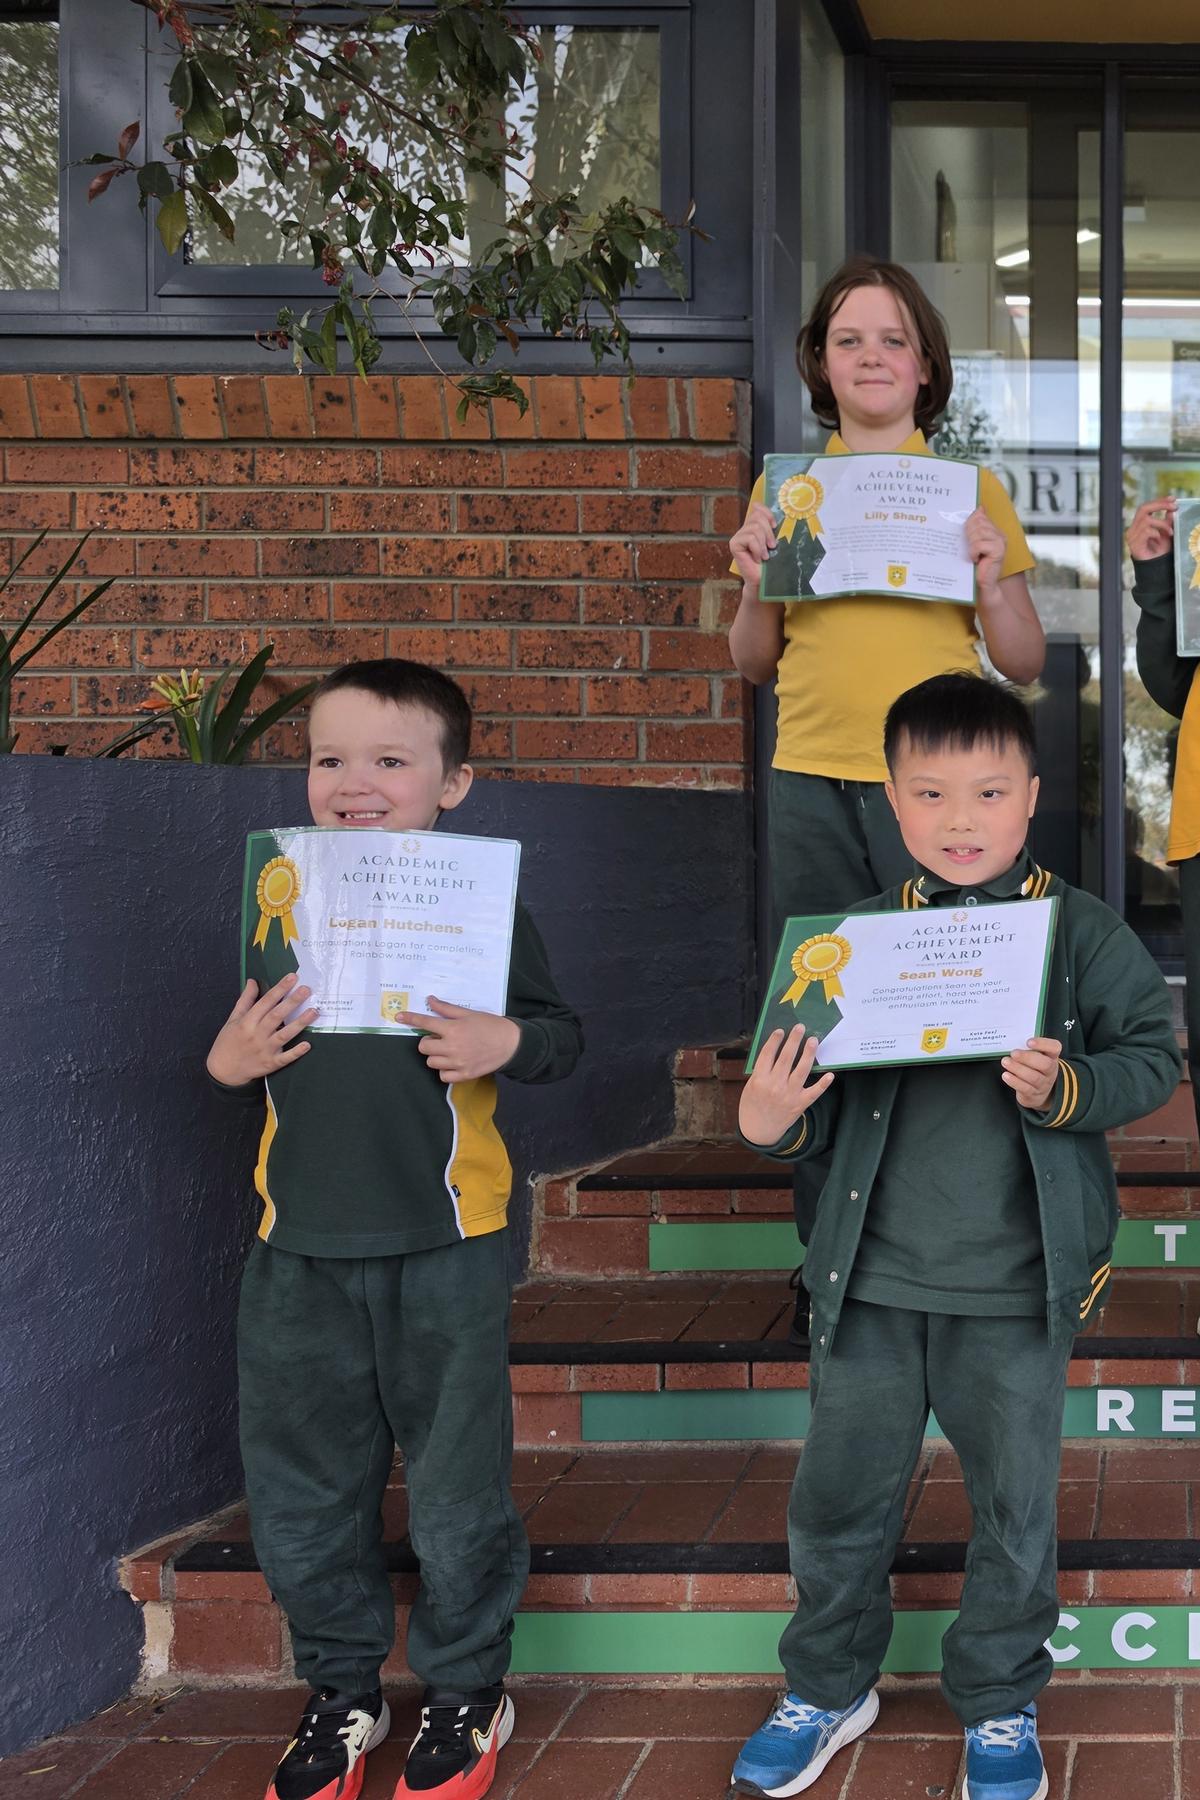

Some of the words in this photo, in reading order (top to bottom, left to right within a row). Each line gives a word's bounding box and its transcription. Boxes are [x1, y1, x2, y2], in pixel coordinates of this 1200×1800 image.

[868, 471, 940, 483] ACADEMIC
[854, 483, 952, 498] ACHIEVEMENT
[879, 496, 927, 506] AWARD
[864, 511, 889, 522] Lilly
[893, 511, 928, 523] Sharp
[359, 855, 459, 872] ACADEMIC
[339, 872, 477, 891] ACHIEVEMENT
[372, 891, 440, 905] AWARD
[329, 917, 378, 931] Logan
[383, 918, 464, 935] Hutchens
[912, 921, 1001, 936] ACADEMIC
[375, 940, 407, 952] Logan
[410, 941, 425, 950] for
[427, 943, 485, 956] completing
[892, 933, 1017, 951] ACHIEVEMENT
[350, 950, 394, 960] Rainbow
[396, 951, 427, 962] Maths
[921, 949, 982, 962] AWARD
[898, 970, 936, 980] Sean
[941, 967, 984, 979] Wong
[872, 984, 943, 995] Congratulations
[945, 982, 967, 990] Sean
[983, 979, 1003, 988] your
[861, 993, 914, 1005] outstanding
[946, 989, 967, 998] hard
[969, 988, 990, 996] work
[992, 986, 1011, 994] and
[888, 1000, 938, 1010] enthusiasm
